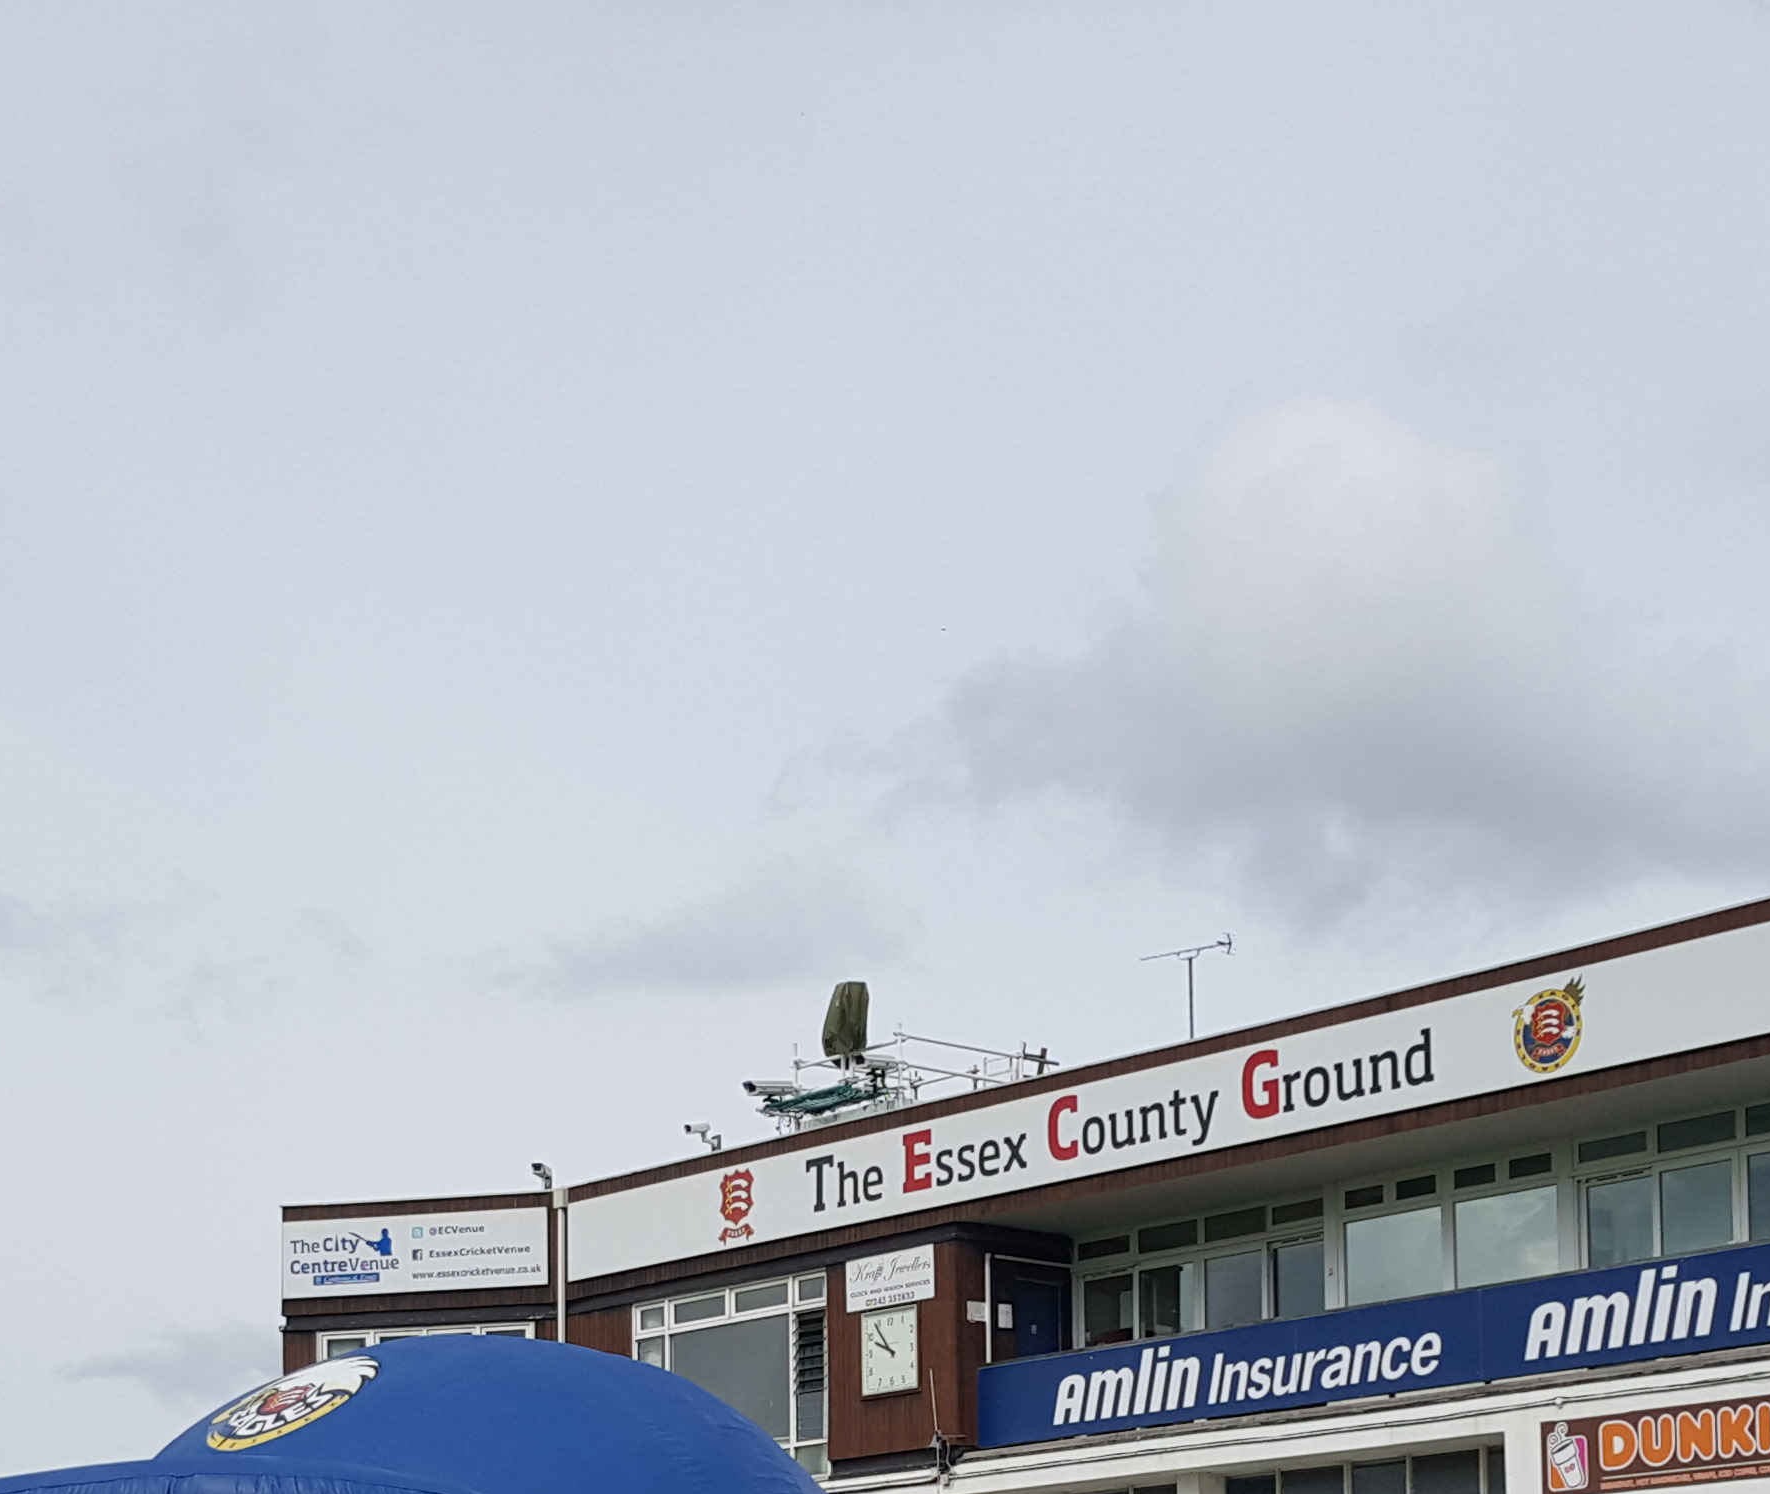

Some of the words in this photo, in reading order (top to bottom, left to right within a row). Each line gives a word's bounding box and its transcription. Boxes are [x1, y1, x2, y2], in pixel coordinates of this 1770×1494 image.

[805, 1154, 883, 1214] The
[903, 1128, 1027, 1194] Essex
[1048, 1089, 1219, 1162] County
[1241, 1028, 1434, 1119] Ground
[428, 1224, 485, 1236] @ECVenue
[290, 1239, 321, 1254] The
[323, 1233, 360, 1253] City
[429, 1245, 531, 1259] EssexCricketVenue
[290, 1257, 400, 1276] CentreVenue
[1524, 1265, 1719, 1361] Amlin
[1054, 1344, 1202, 1425] Amlin
[1209, 1332, 1441, 1406] Insurance
